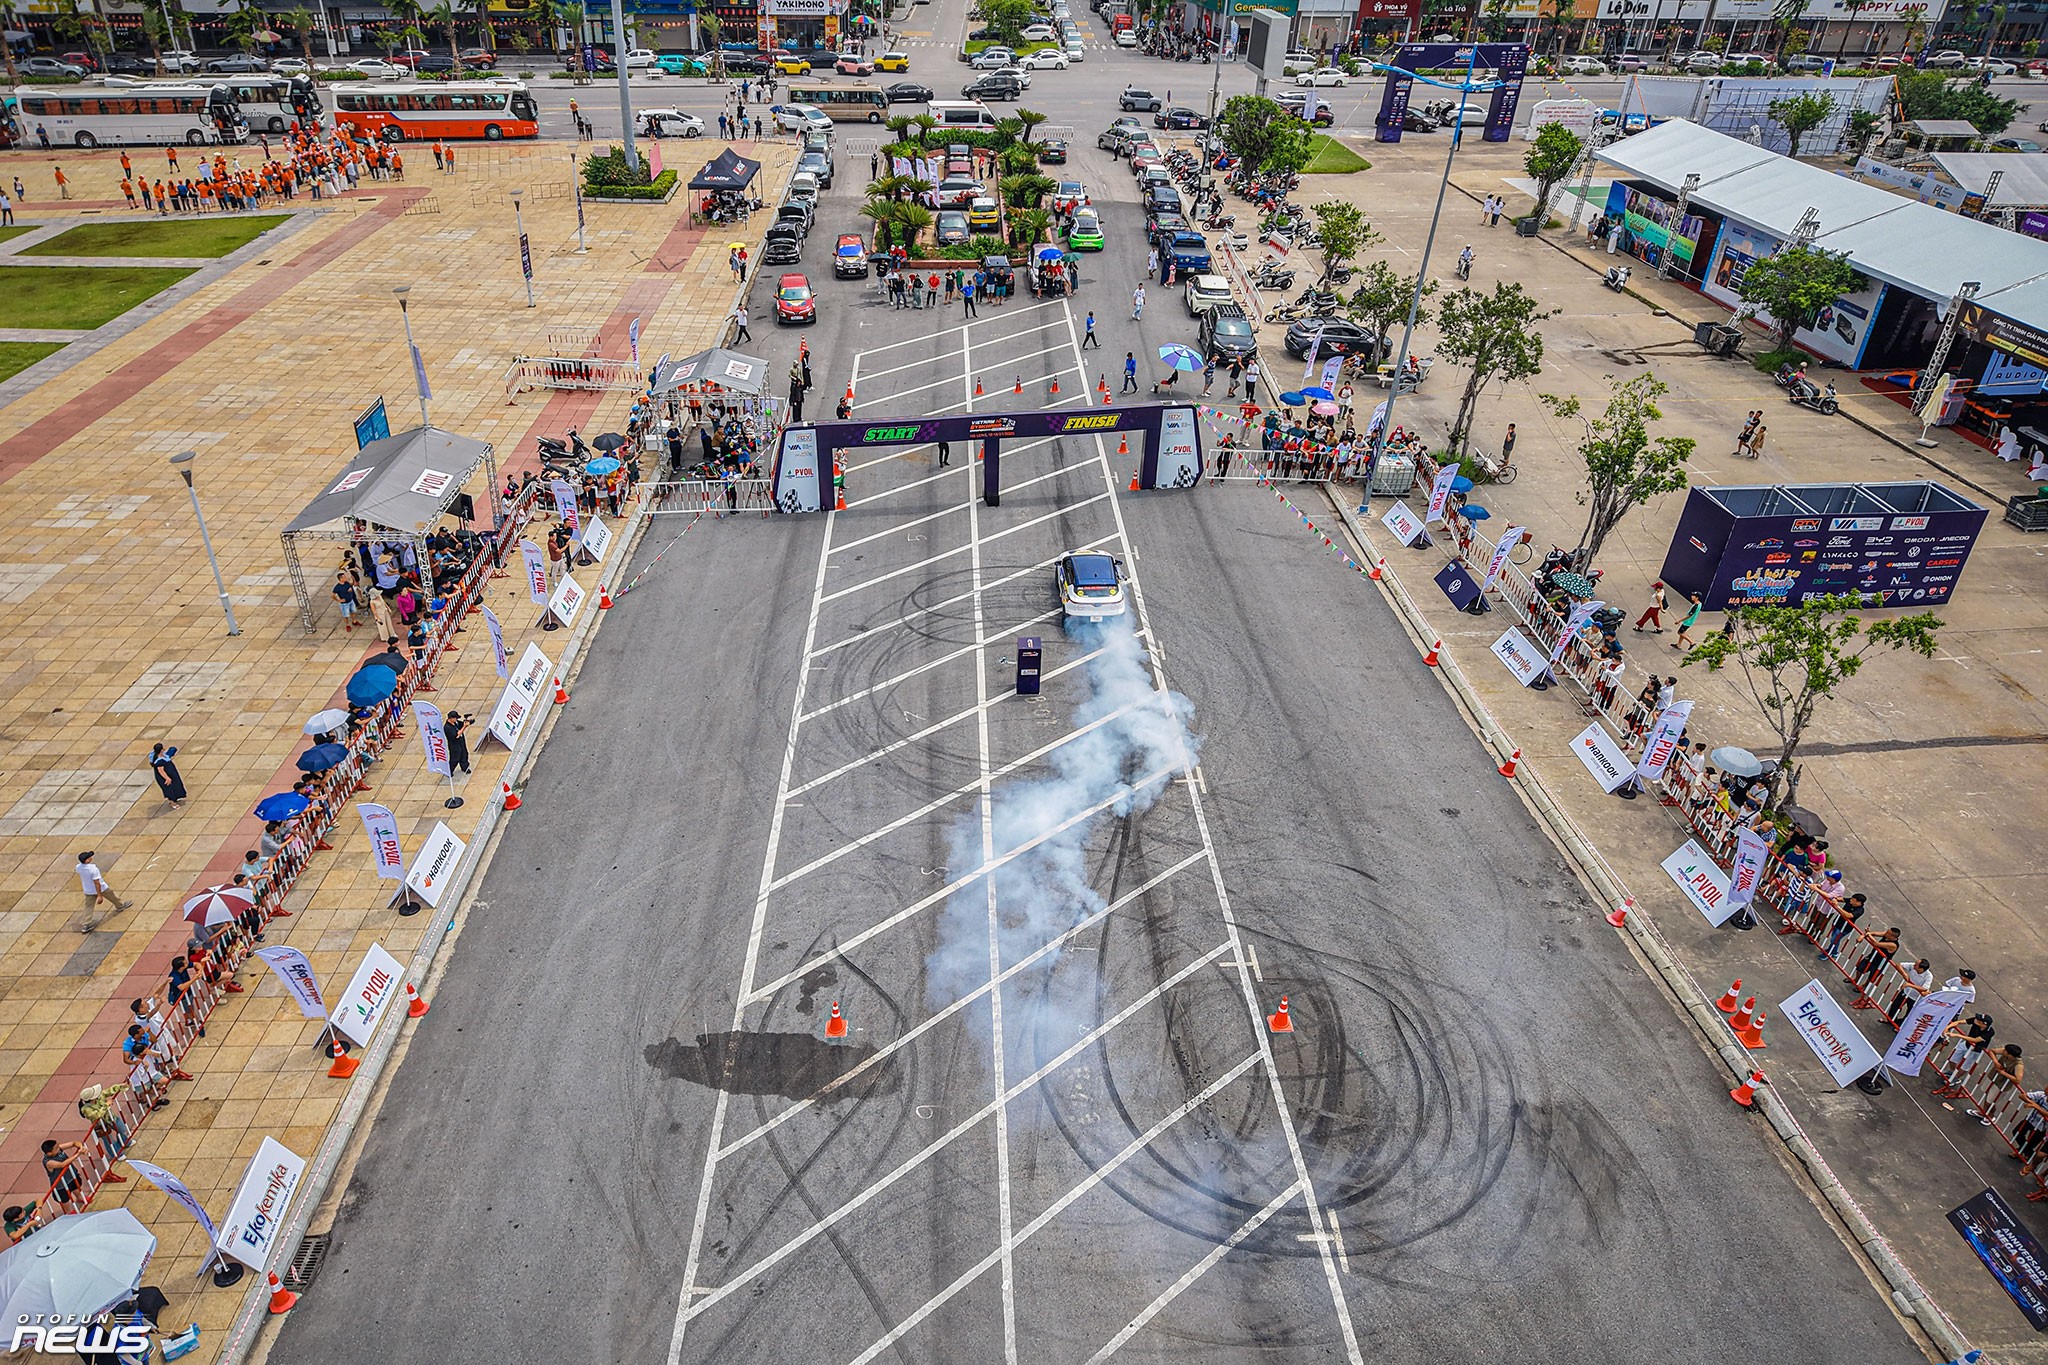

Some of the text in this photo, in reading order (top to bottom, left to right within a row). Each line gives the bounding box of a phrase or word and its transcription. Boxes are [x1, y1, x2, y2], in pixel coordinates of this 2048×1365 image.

[776, 0, 824, 8] YAKIMONO
[1848, 2, 1892, 12] APPY
[1996, 371, 2037, 379] AUDIO
[1065, 414, 1118, 429] FINISH
[865, 428, 918, 441] START
[1173, 445, 1192, 453] PVOIL
[1398, 518, 1412, 536] PVOIL
[1905, 517, 1925, 526] PVOIL
[1927, 559, 1960, 567] CARSEN
[563, 588, 578, 609] PVOIL
[1502, 639, 1533, 674] Ekokemika
[505, 701, 523, 725] PVOIL
[1648, 739, 1673, 767] PVOIL
[382, 840, 400, 866] PVOIL
[1692, 872, 1723, 908] PVOIL
[362, 967, 390, 1005] PVOIL
[1798, 1000, 1852, 1067] Ekokemika
[241, 1162, 288, 1247] Ekokemika
[1993, 1228, 2018, 1257] MEGA
[2001, 1227, 2048, 1288] ANNIVERSARY
